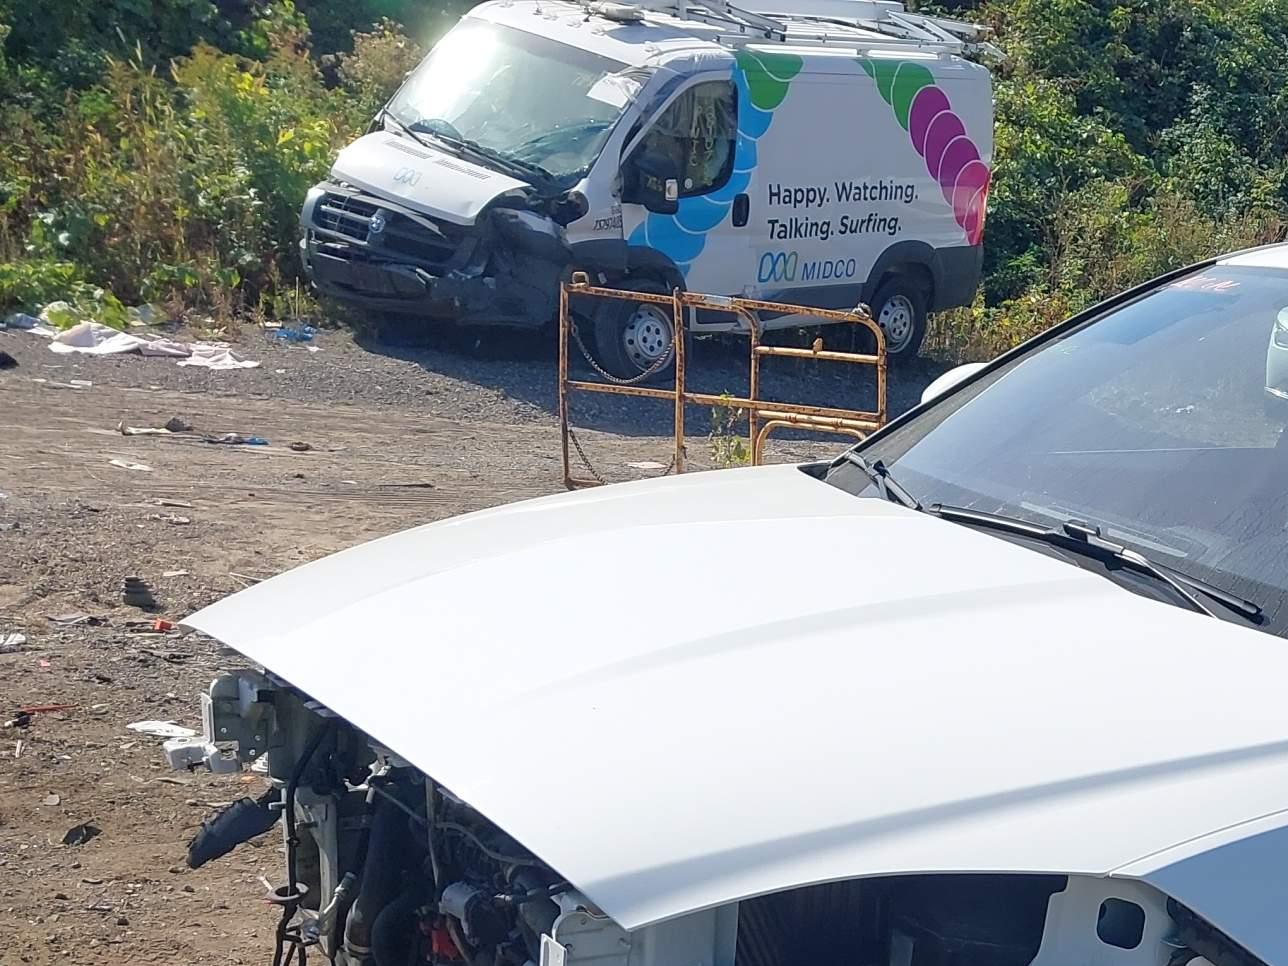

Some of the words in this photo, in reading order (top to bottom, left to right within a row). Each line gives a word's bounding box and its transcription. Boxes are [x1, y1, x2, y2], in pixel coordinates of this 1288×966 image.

[768, 184, 830, 208] Happy.
[835, 180, 919, 204] Watching.
[767, 217, 834, 240] Talking.
[838, 213, 902, 236] Surfing.
[801, 259, 856, 281] MIDCO
